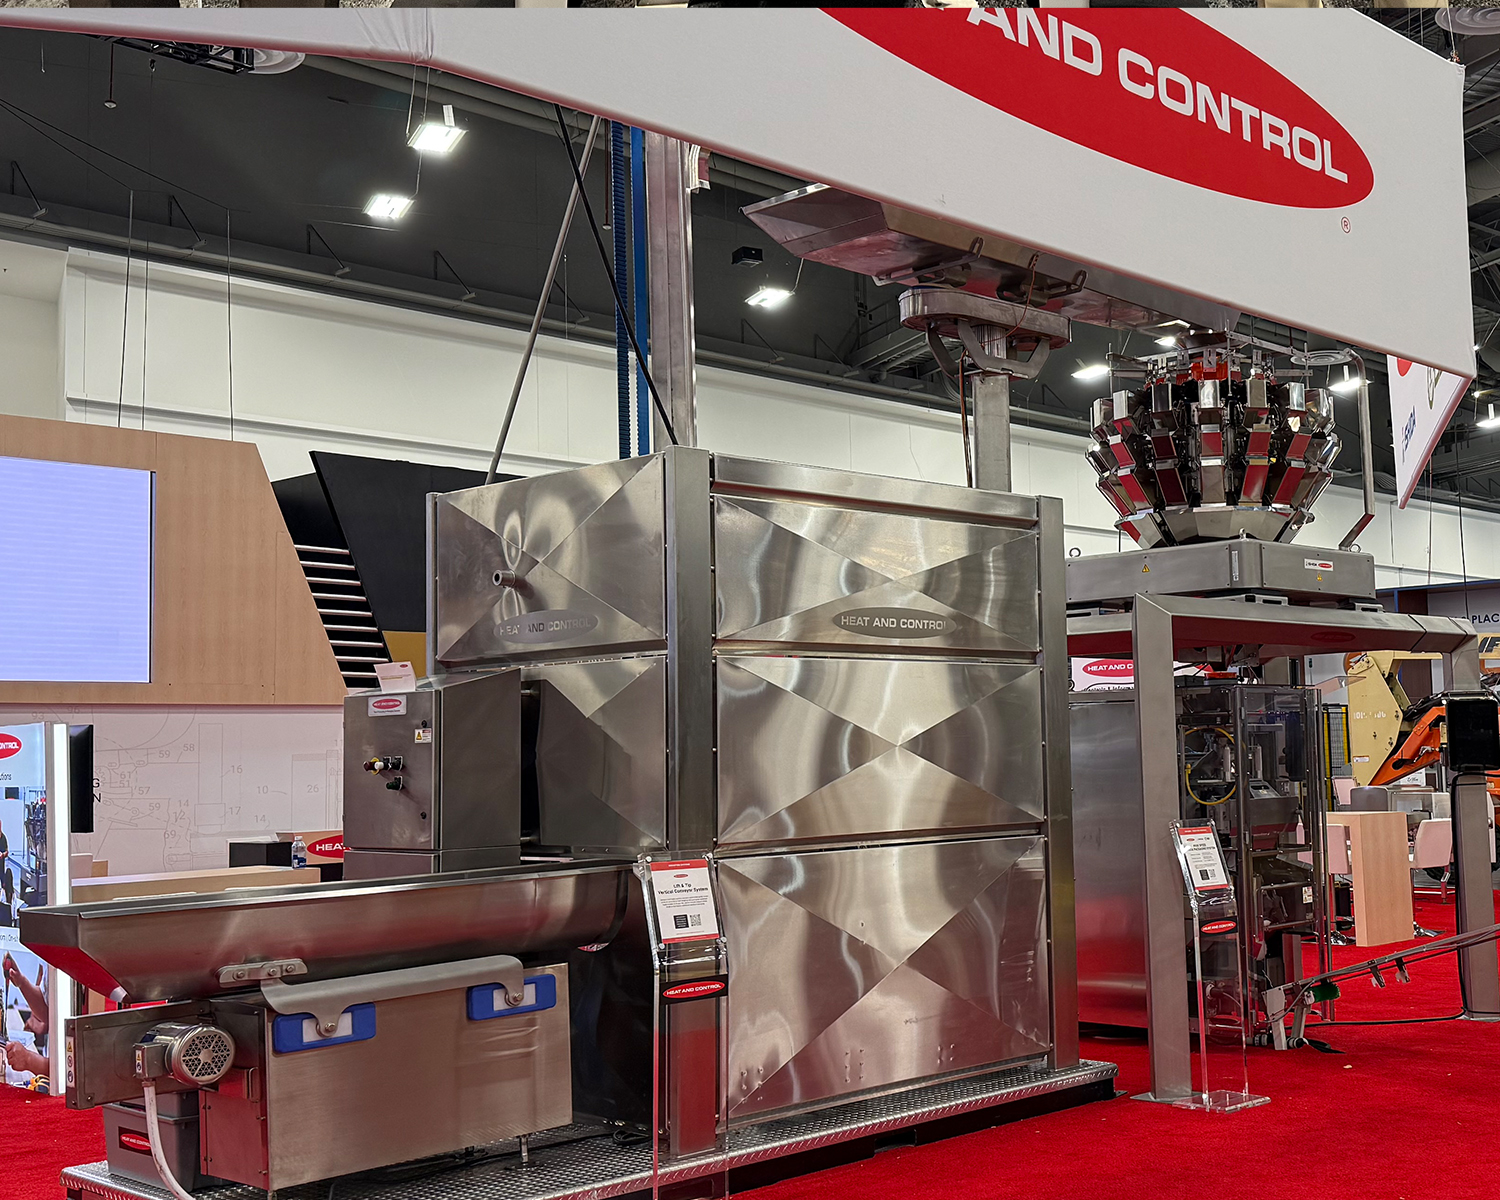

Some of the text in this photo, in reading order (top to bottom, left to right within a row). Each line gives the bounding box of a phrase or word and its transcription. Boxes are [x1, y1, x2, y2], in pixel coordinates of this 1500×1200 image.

[966, 8, 1349, 184] AND CONTROL
[526, 621, 545, 633] AND
[547, 617, 592, 632] CONTROL
[841, 616, 870, 627] HEAT
[872, 617, 897, 628] AND
[183, 743, 195, 752] 58
[158, 750, 171, 759] 59
[231, 764, 243, 774] 16
[138, 786, 151, 795] 57
[256, 785, 269, 794] 10
[306, 784, 320, 793] 26
[148, 802, 161, 812] 59
[228, 807, 241, 816] 17
[695, 984, 722, 992] CONTROL
